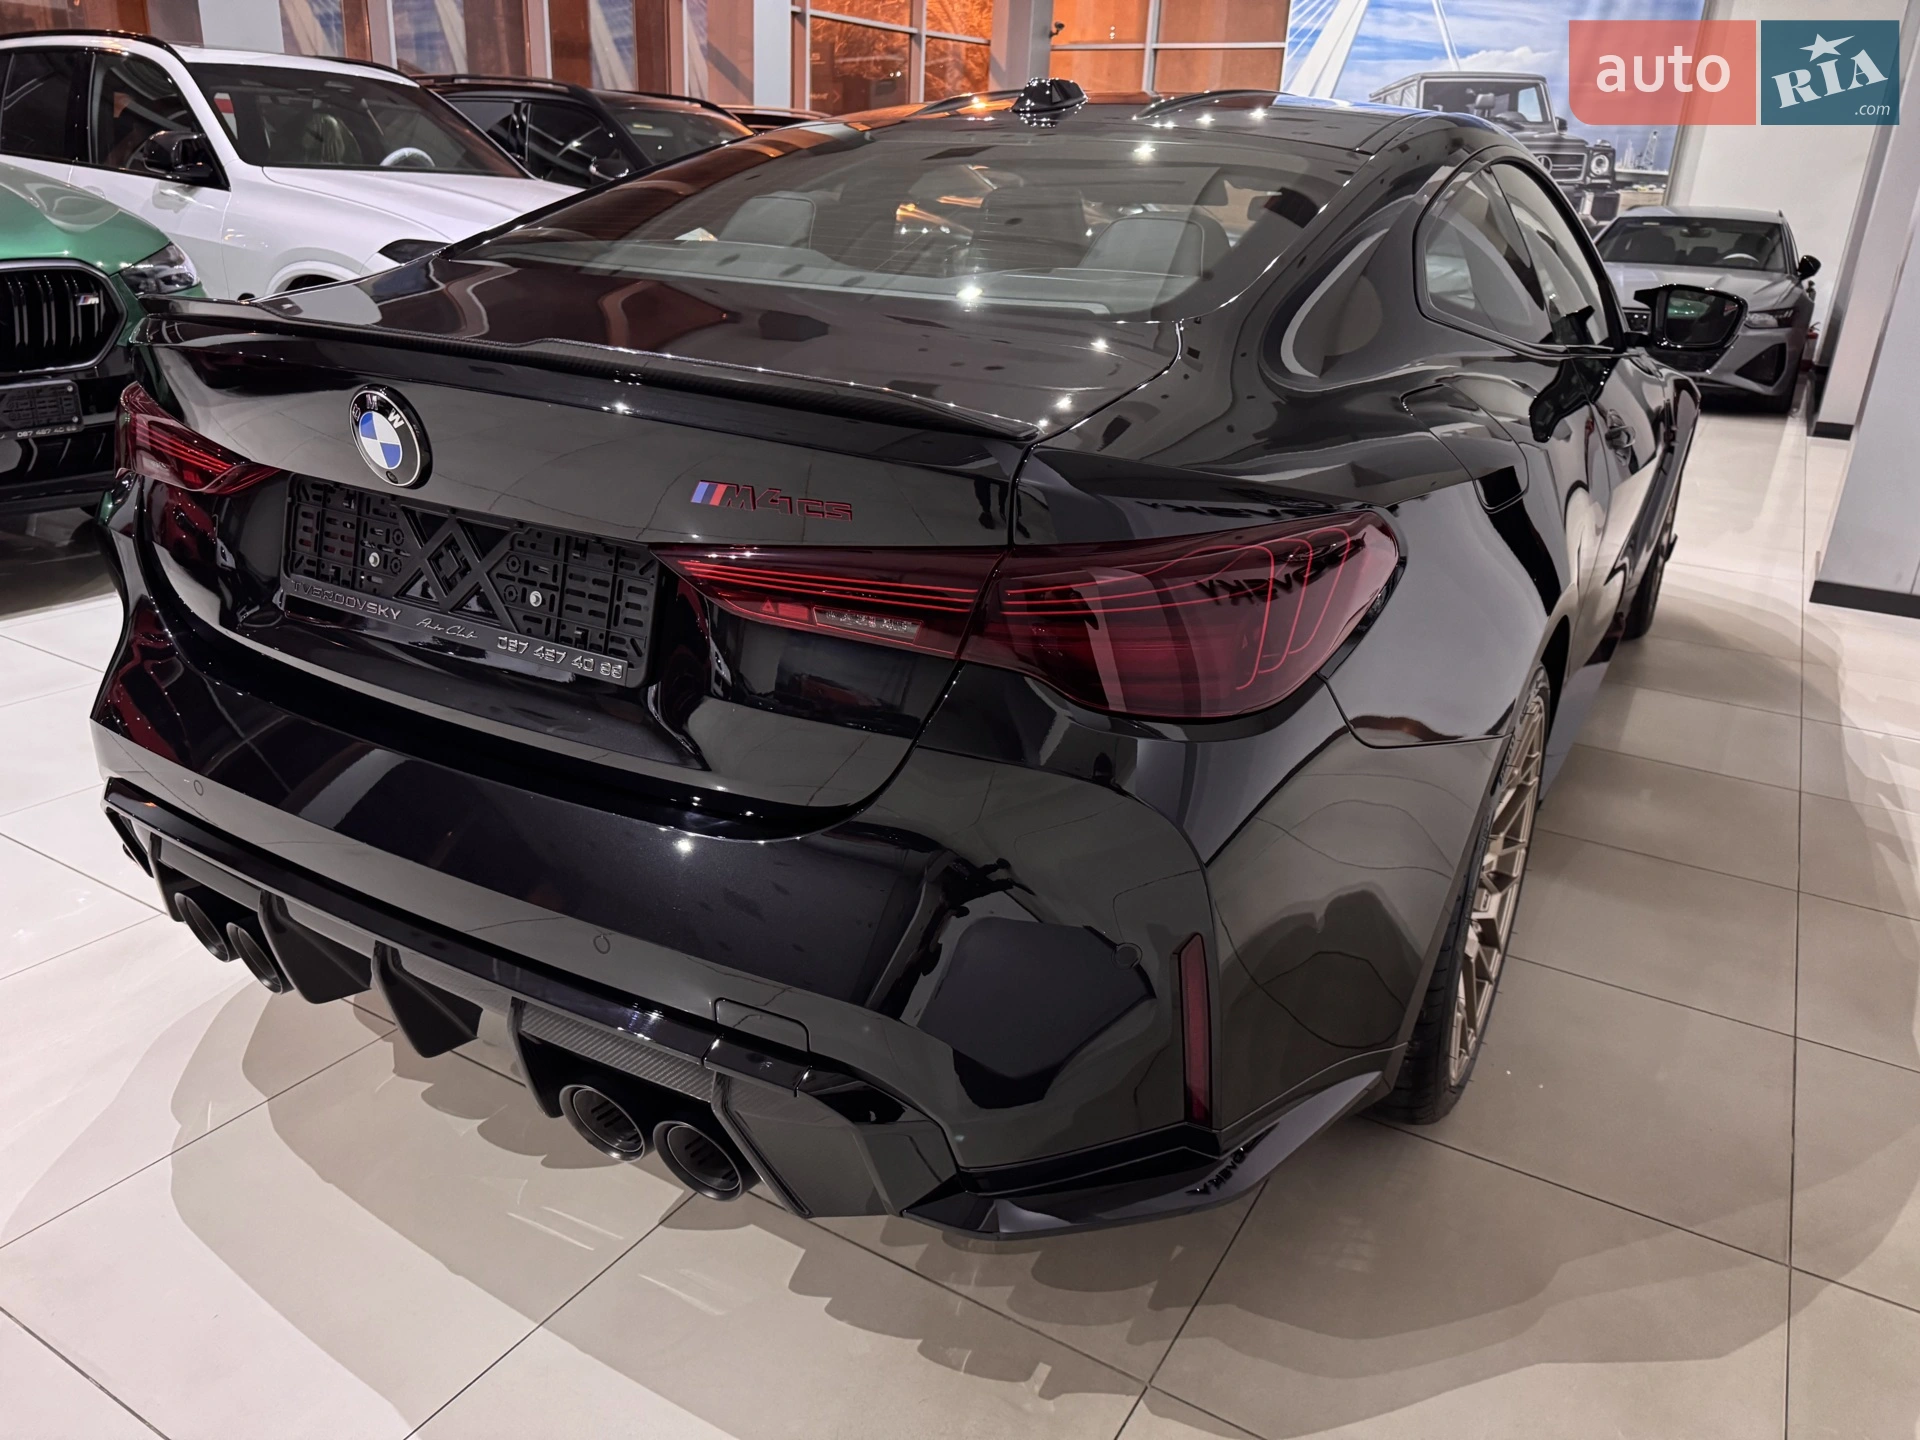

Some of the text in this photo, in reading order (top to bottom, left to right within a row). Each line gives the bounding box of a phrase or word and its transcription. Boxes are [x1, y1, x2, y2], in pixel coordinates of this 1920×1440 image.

[352, 393, 405, 429] BMW
[291, 580, 402, 620] TVERDOVSKY
[416, 617, 445, 631] Auto
[446, 625, 478, 639] Club
[571, 655, 594, 672] 40
